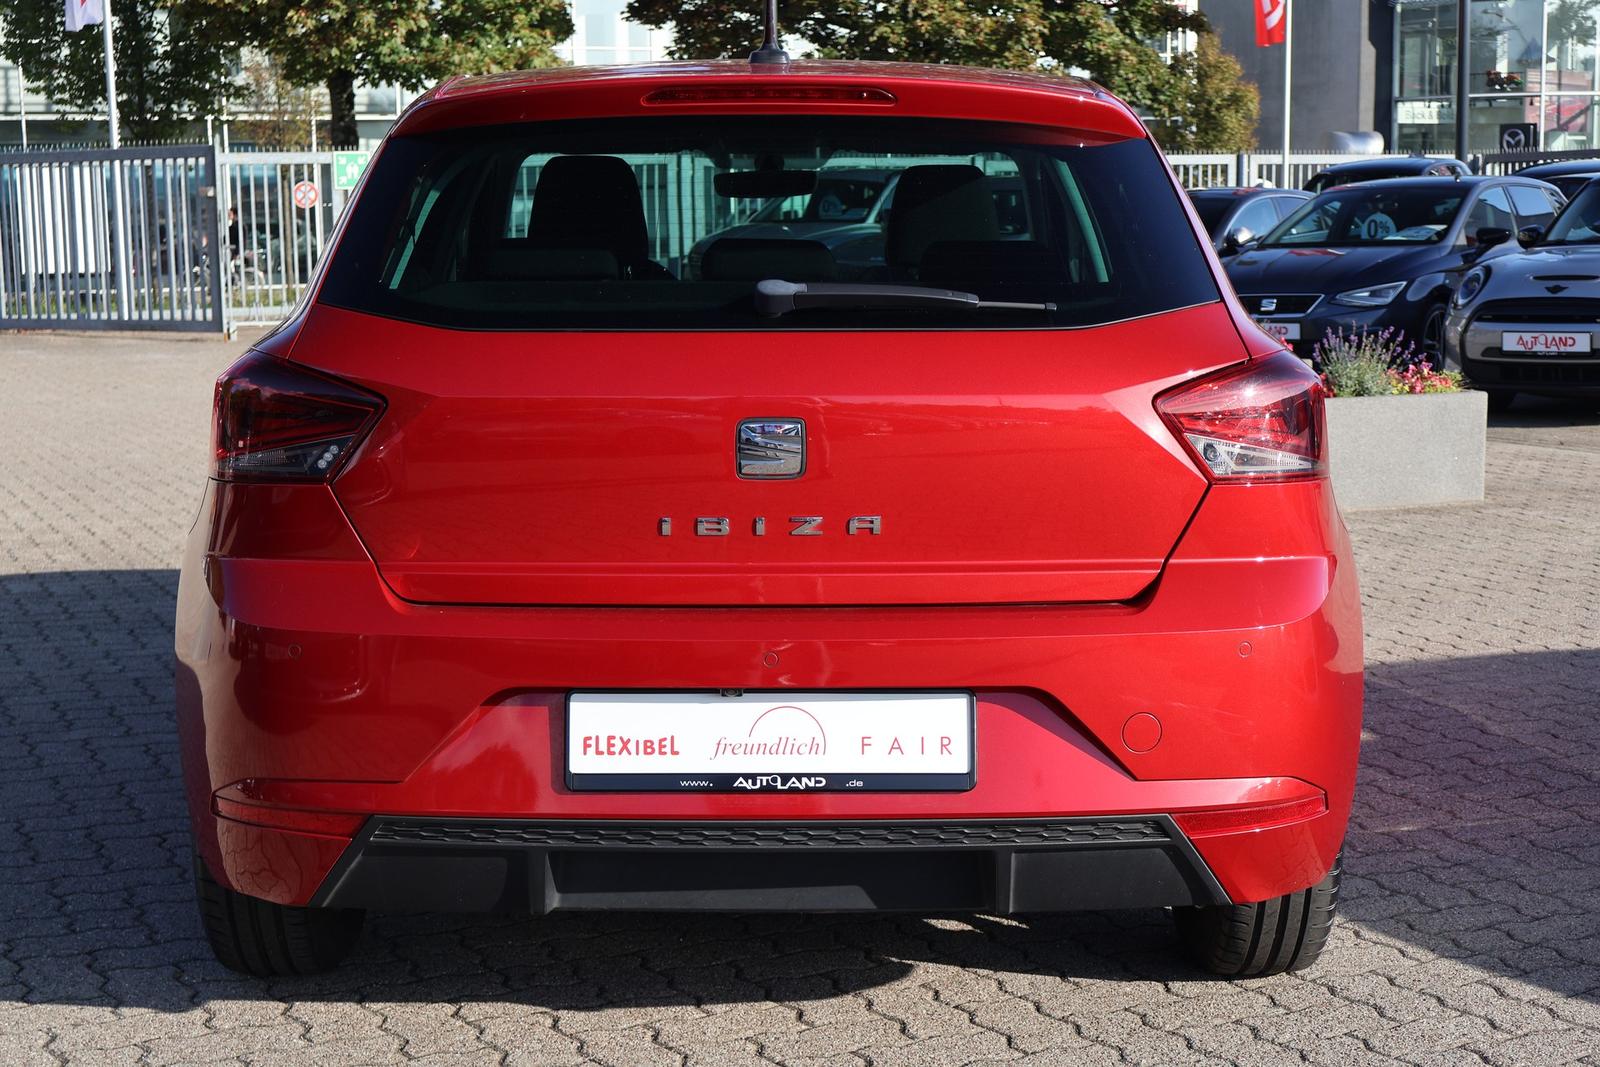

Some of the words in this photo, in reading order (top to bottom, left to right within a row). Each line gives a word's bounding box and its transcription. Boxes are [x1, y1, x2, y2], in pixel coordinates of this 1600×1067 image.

[1516, 333, 1576, 351] AUTOLAND
[657, 515, 882, 536] IBIZA
[582, 734, 680, 756] FLEXIBEL
[709, 736, 821, 760] freundlich
[861, 736, 953, 755] FAIR
[732, 774, 826, 790] AUTOLAND
